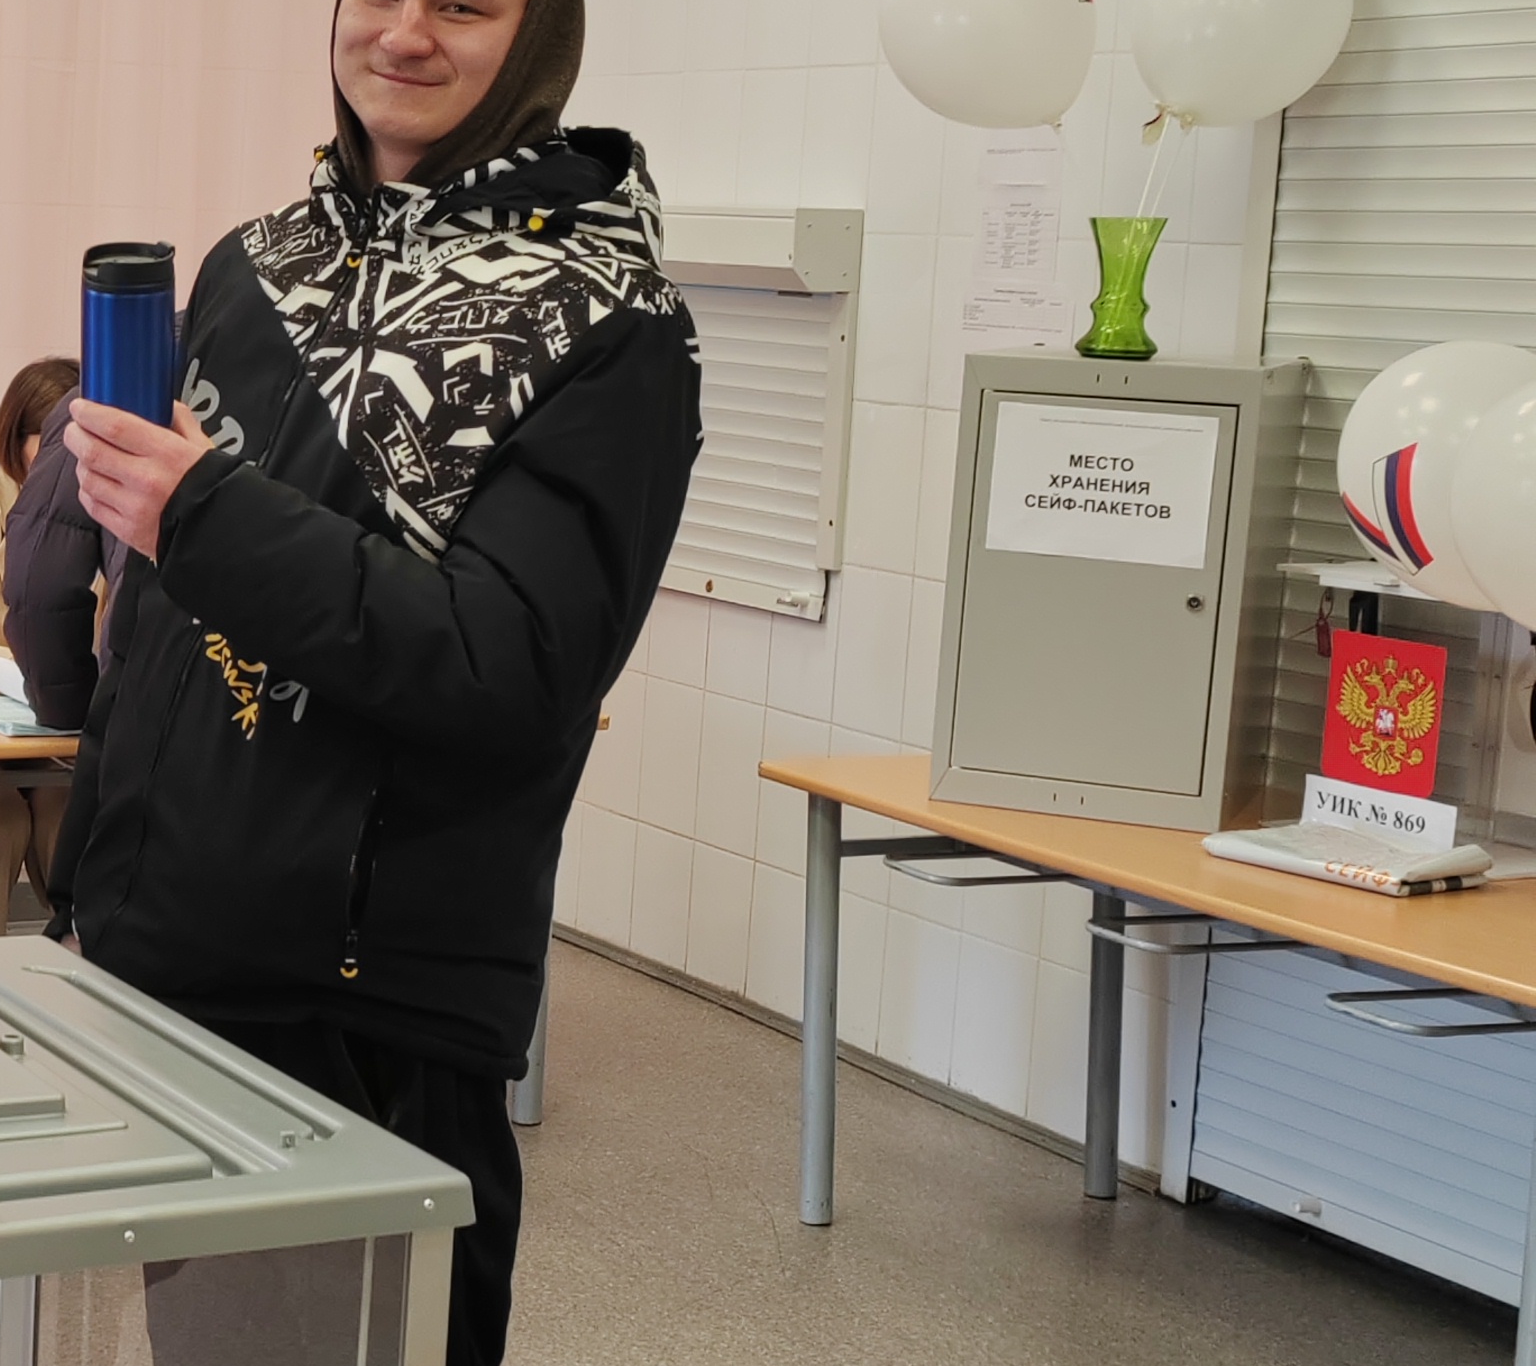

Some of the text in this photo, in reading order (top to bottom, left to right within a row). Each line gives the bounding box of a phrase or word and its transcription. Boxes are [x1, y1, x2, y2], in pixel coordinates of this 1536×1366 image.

[1068, 454, 1135, 472] МЕСТО
[1048, 474, 1151, 496] ХРАНЕНИЯ
[1024, 493, 1172, 519] СЕЙФ-ПАКЕТОВ
[1316, 791, 1426, 834] УИК № 869
